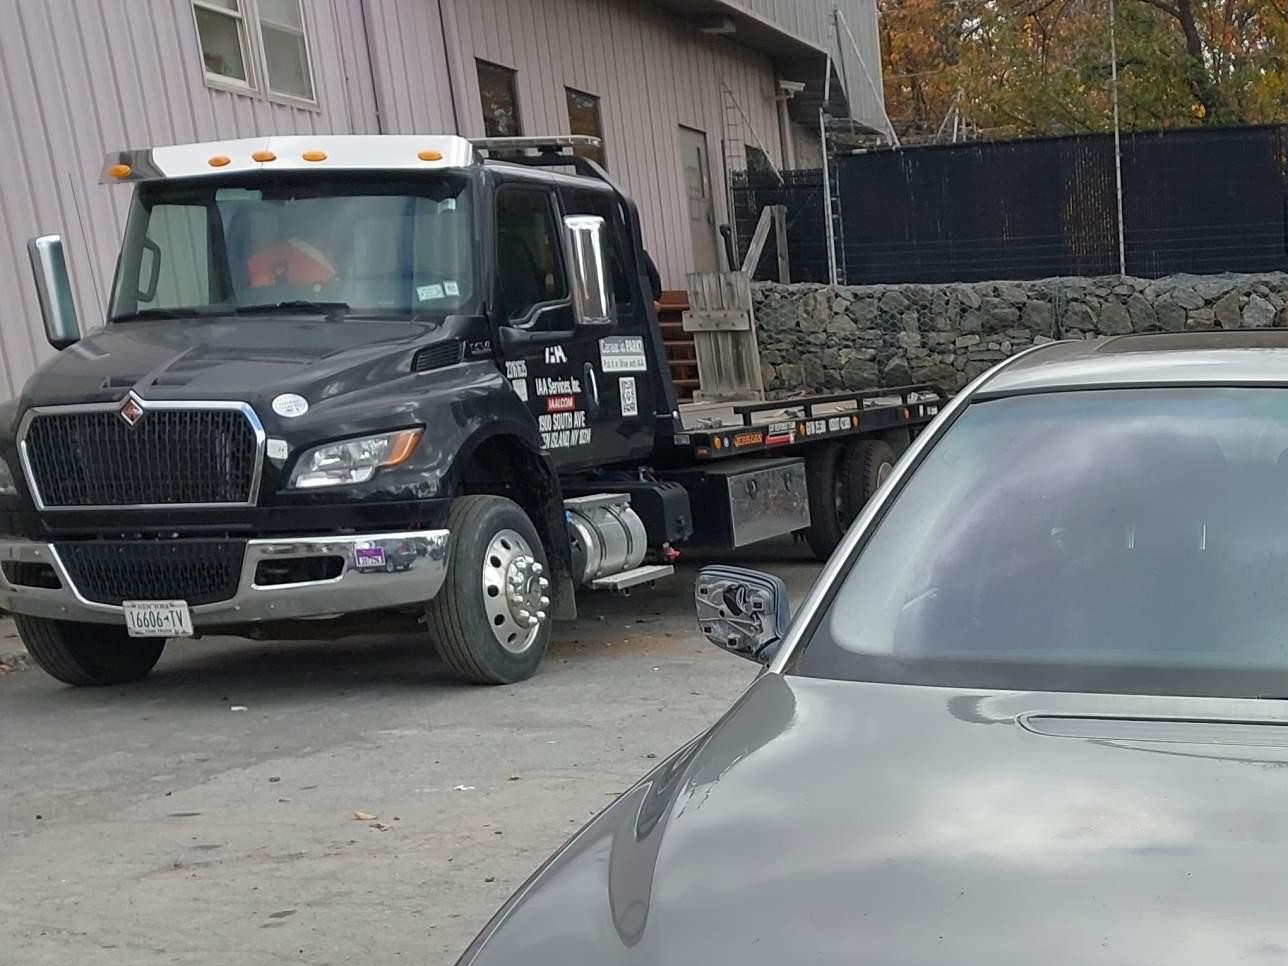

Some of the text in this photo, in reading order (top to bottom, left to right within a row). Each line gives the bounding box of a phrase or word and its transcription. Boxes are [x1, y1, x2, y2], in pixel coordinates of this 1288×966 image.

[536, 378, 549, 396] IAA
[553, 413, 573, 430] SOUTH
[574, 411, 586, 427] AVE
[571, 430, 580, 447] NY
